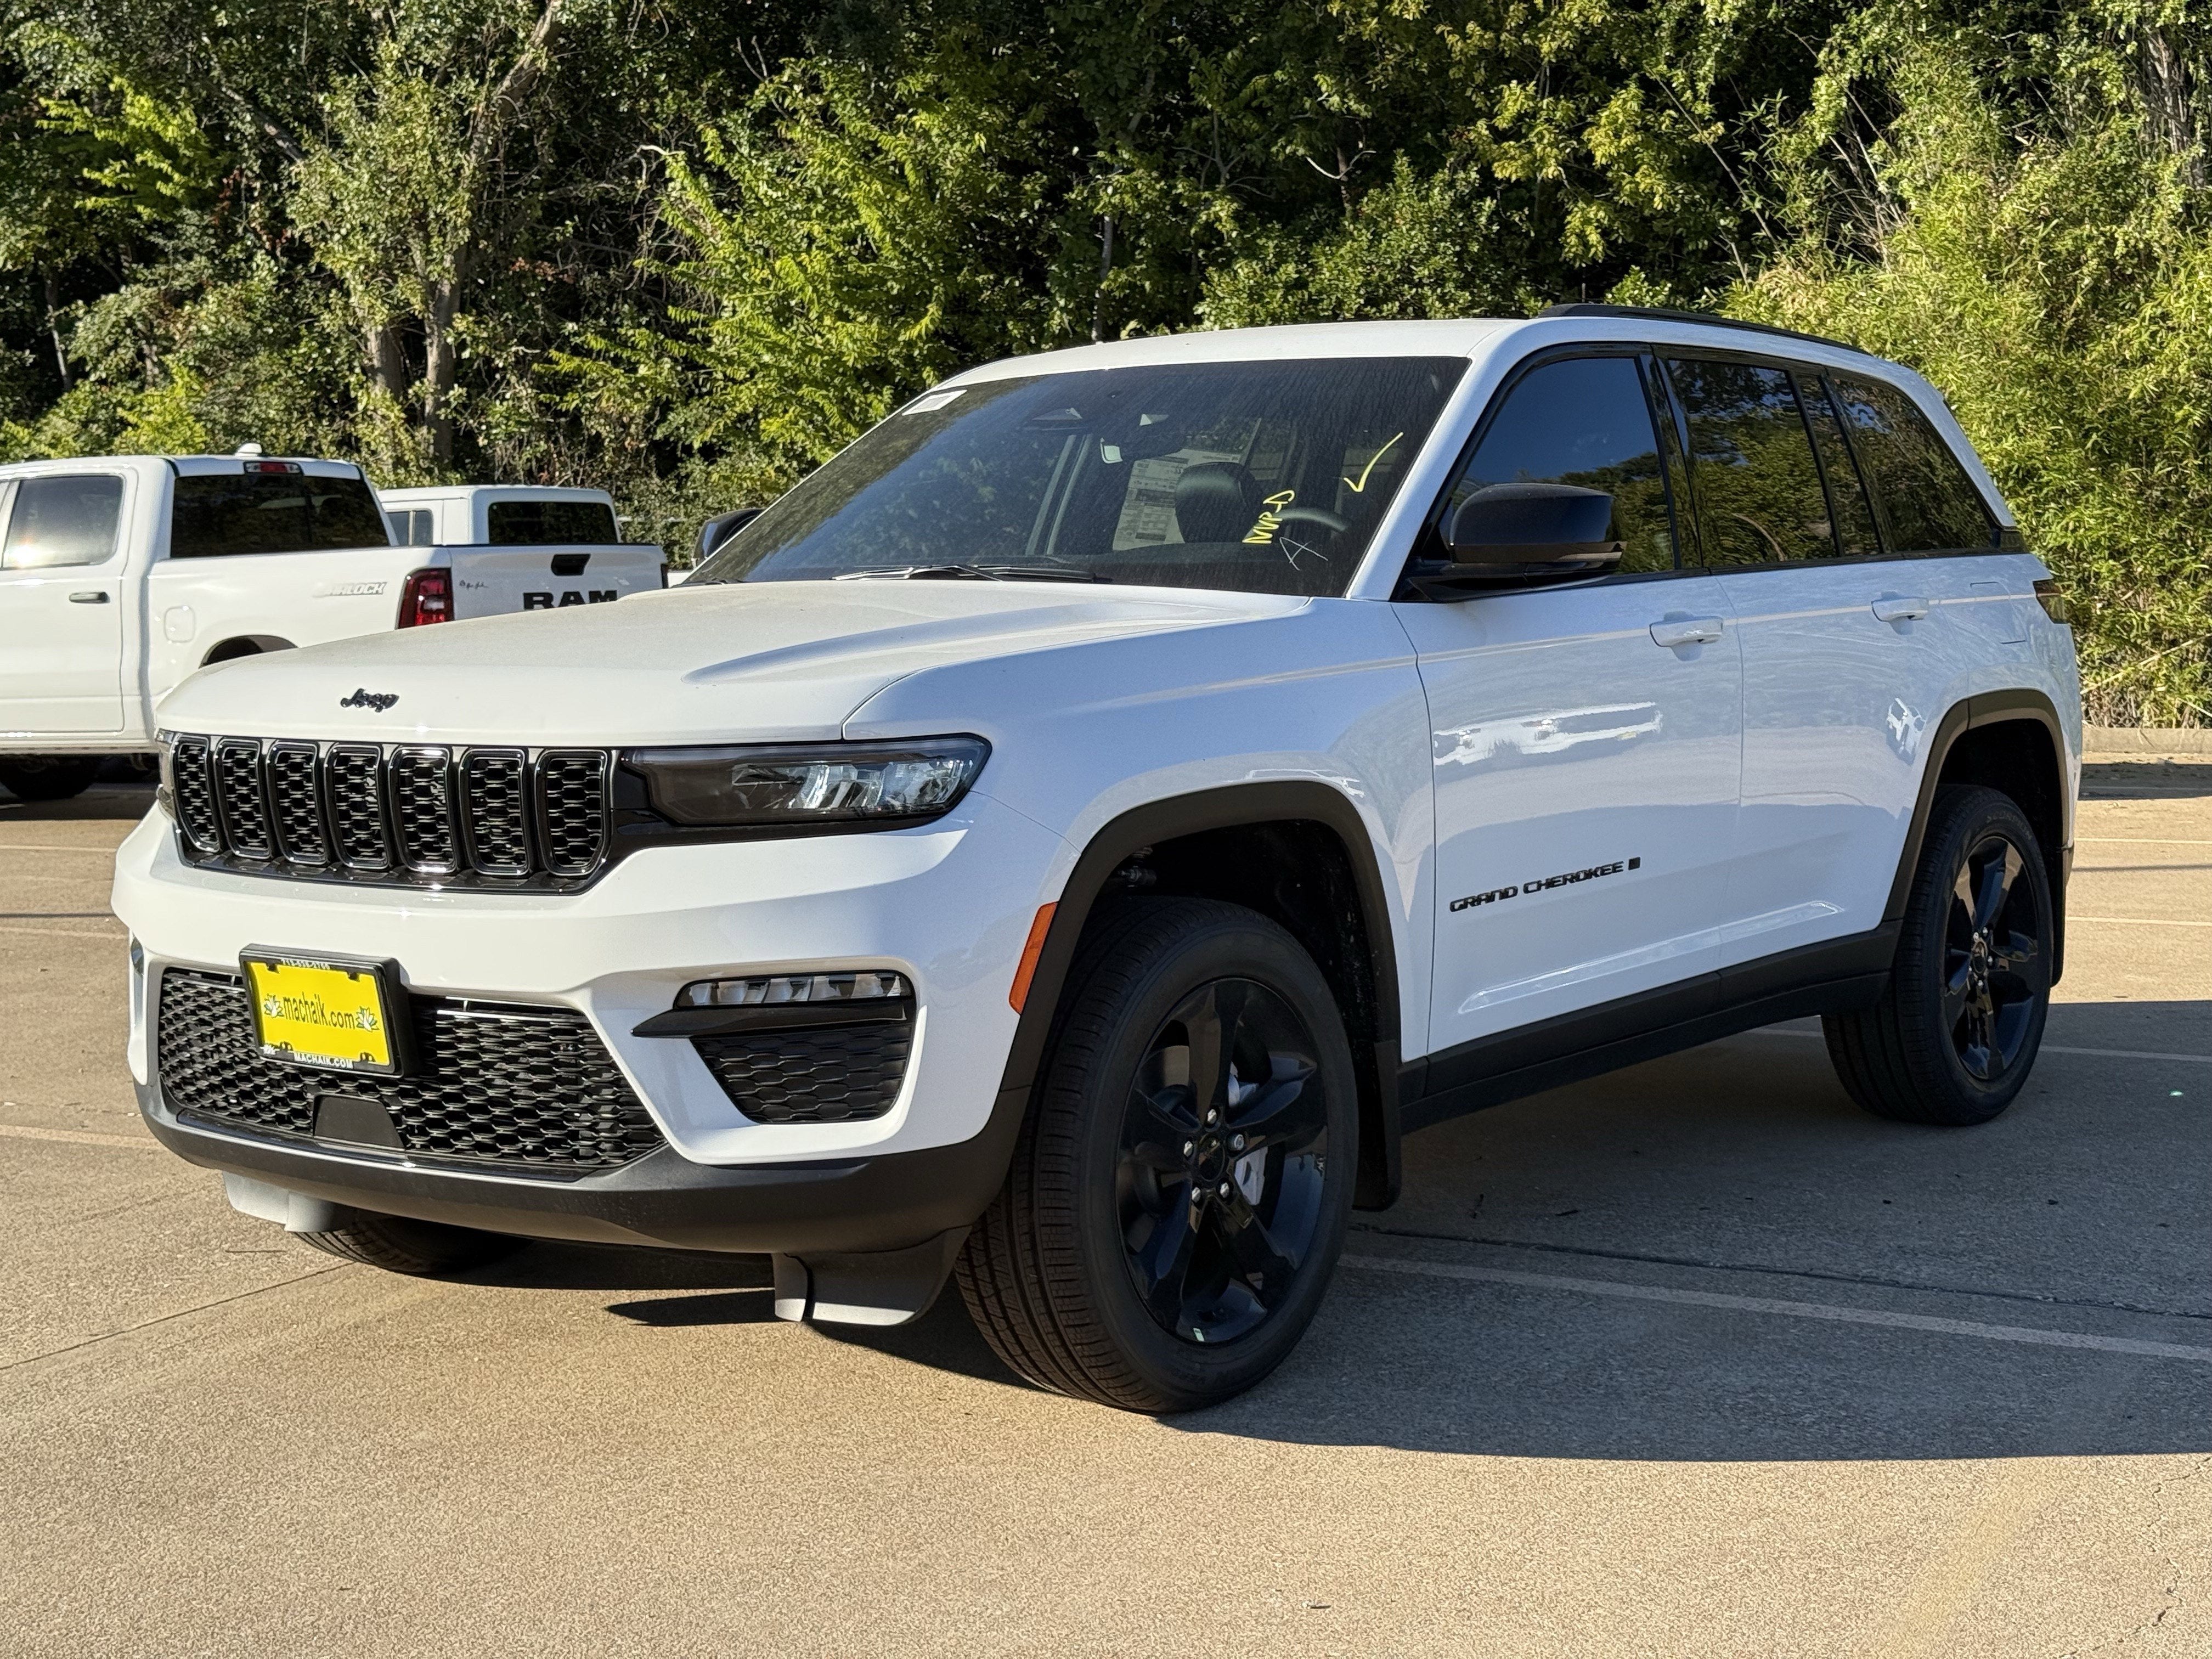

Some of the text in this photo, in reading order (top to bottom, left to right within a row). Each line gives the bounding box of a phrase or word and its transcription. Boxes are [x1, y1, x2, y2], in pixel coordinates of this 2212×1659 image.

[523, 590, 617, 610] RAM
[340, 688, 400, 713] Jeep
[1449, 861, 1624, 912] GRAND CHEROKEE
[282, 991, 356, 1029] machaik.com
[294, 1052, 354, 1069] MACHAIK.COM
